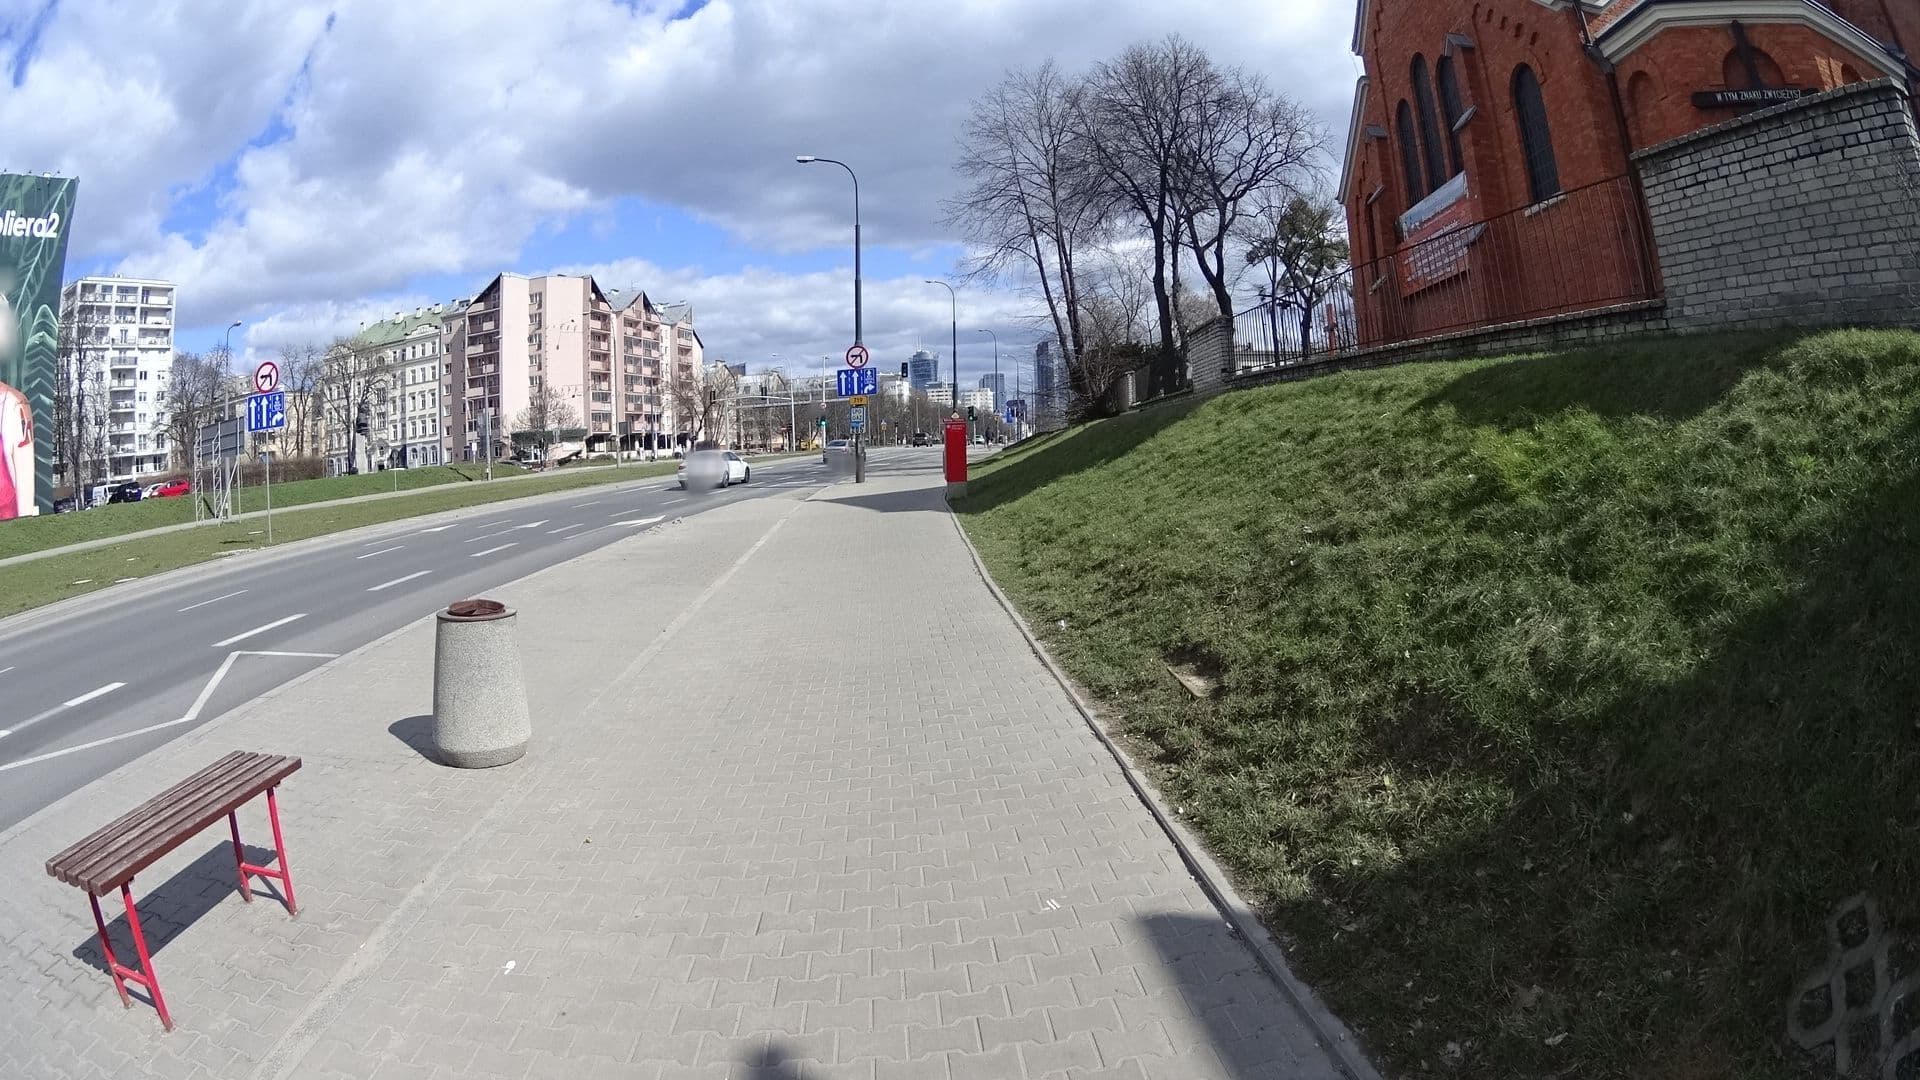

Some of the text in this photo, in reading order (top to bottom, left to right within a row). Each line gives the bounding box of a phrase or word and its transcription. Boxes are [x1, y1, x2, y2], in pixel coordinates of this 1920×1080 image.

[1715, 92, 1722, 101] W
[1723, 91, 1738, 101] TYM
[1739, 89, 1762, 101] ZNAKU
[0, 209, 60, 238] liera2
